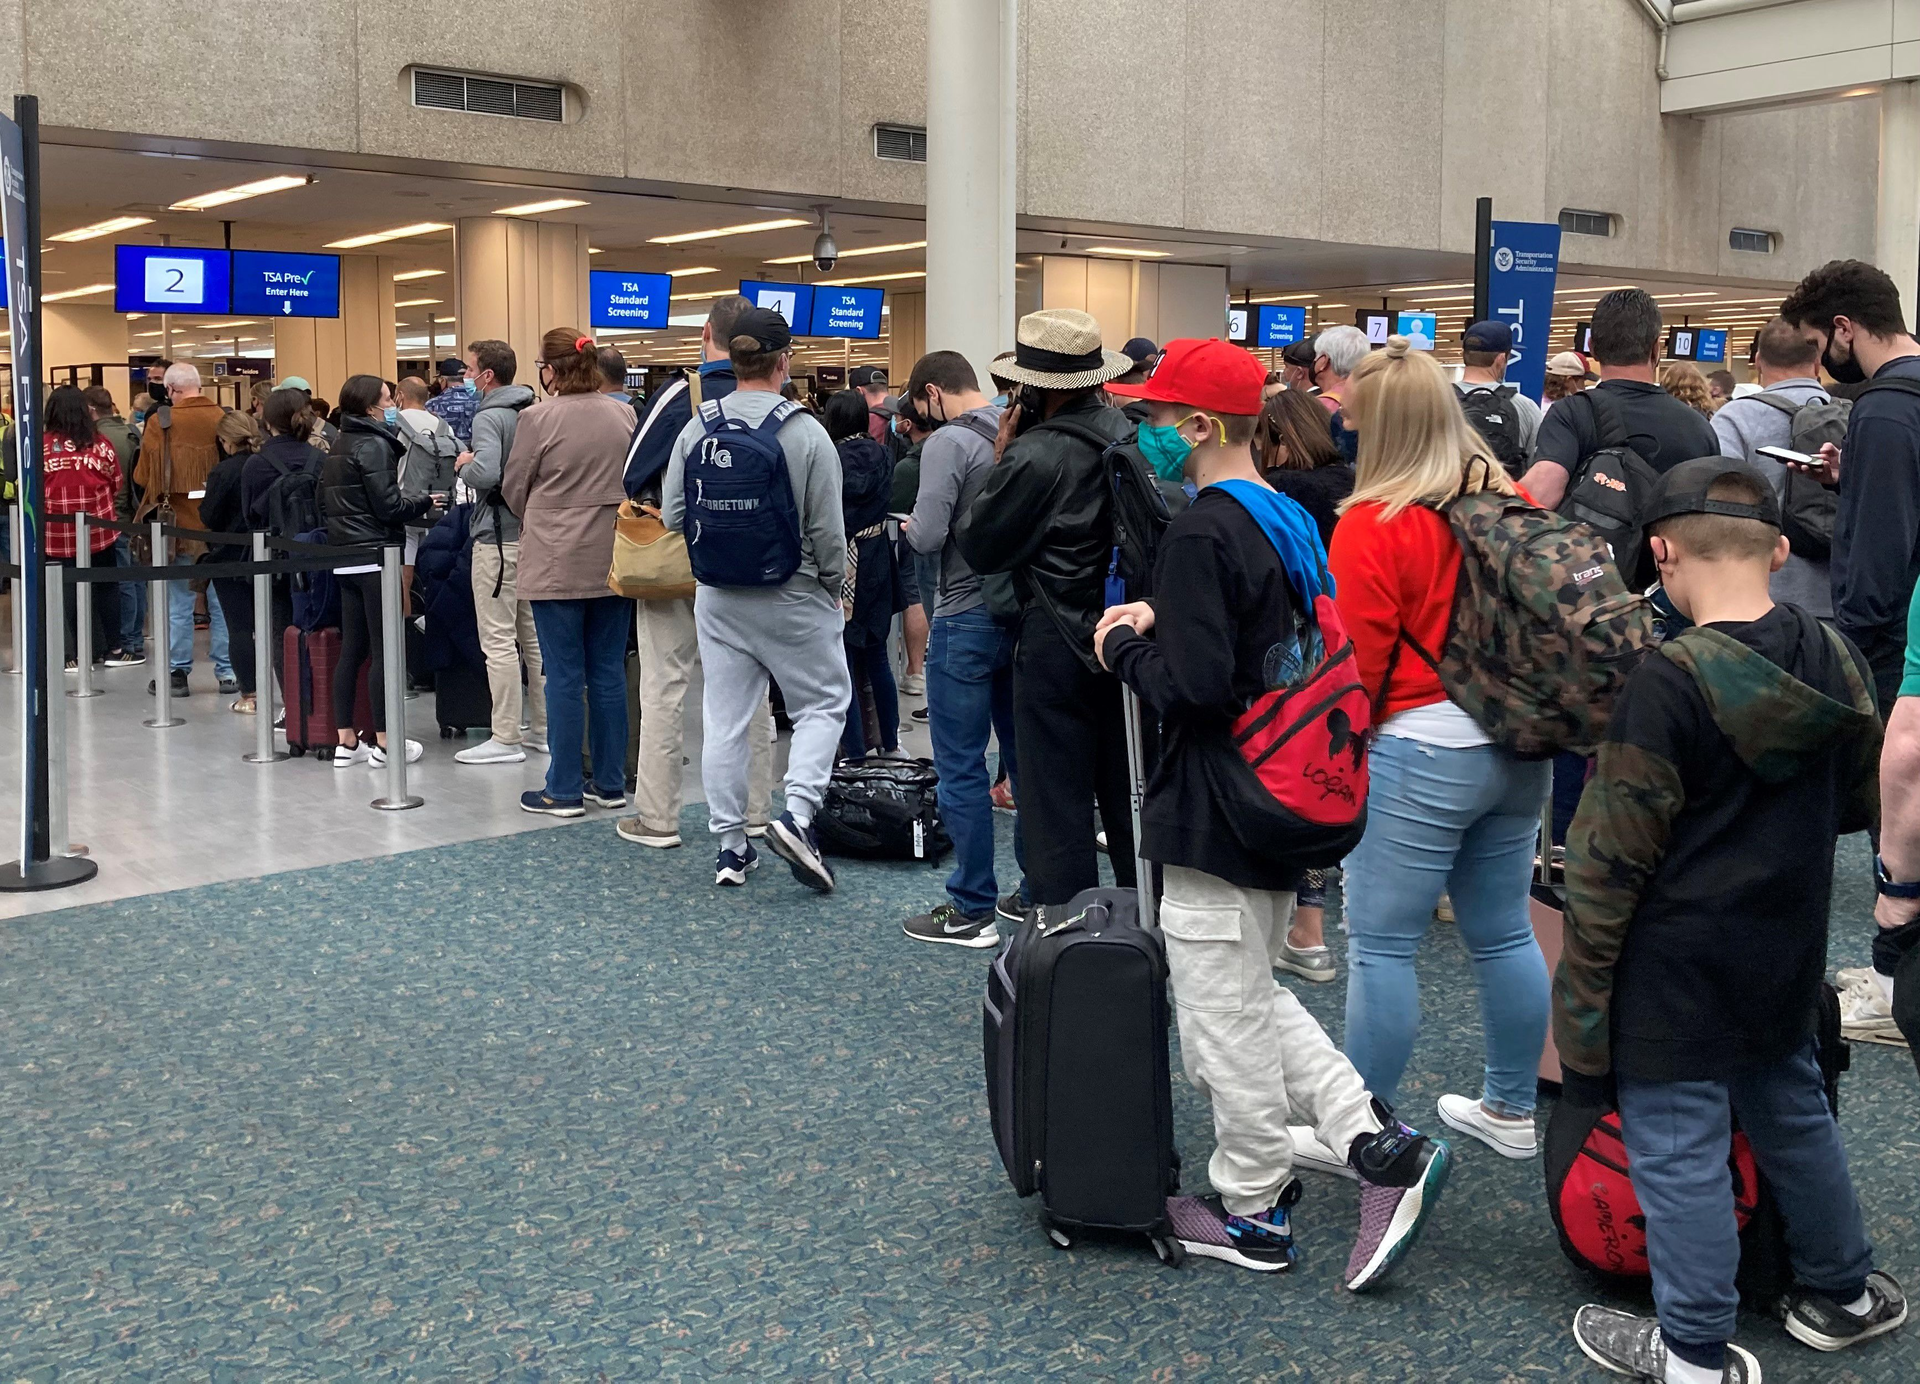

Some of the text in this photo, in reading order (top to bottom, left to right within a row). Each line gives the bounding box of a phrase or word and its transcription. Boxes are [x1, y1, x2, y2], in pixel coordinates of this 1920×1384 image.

[1515, 258, 1537, 266] Security
[164, 268, 185, 293] 2
[263, 271, 282, 283] TSA
[265, 287, 309, 297] Enter Here
[622, 282, 639, 292] TSA
[16, 246, 28, 357] TSA
[610, 294, 649, 305] Standard
[841, 296, 856, 305] TSA
[607, 307, 649, 320] Screening
[831, 307, 864, 317] Standard
[1277, 313, 1288, 321] TSA
[828, 318, 864, 330] Screening
[1229, 317, 1239, 333] 6
[1270, 323, 1293, 331] Standard
[1374, 322, 1382, 338] 7
[1269, 332, 1294, 342] Screening
[1677, 337, 1690, 350] 10
[714, 449, 733, 468] G
